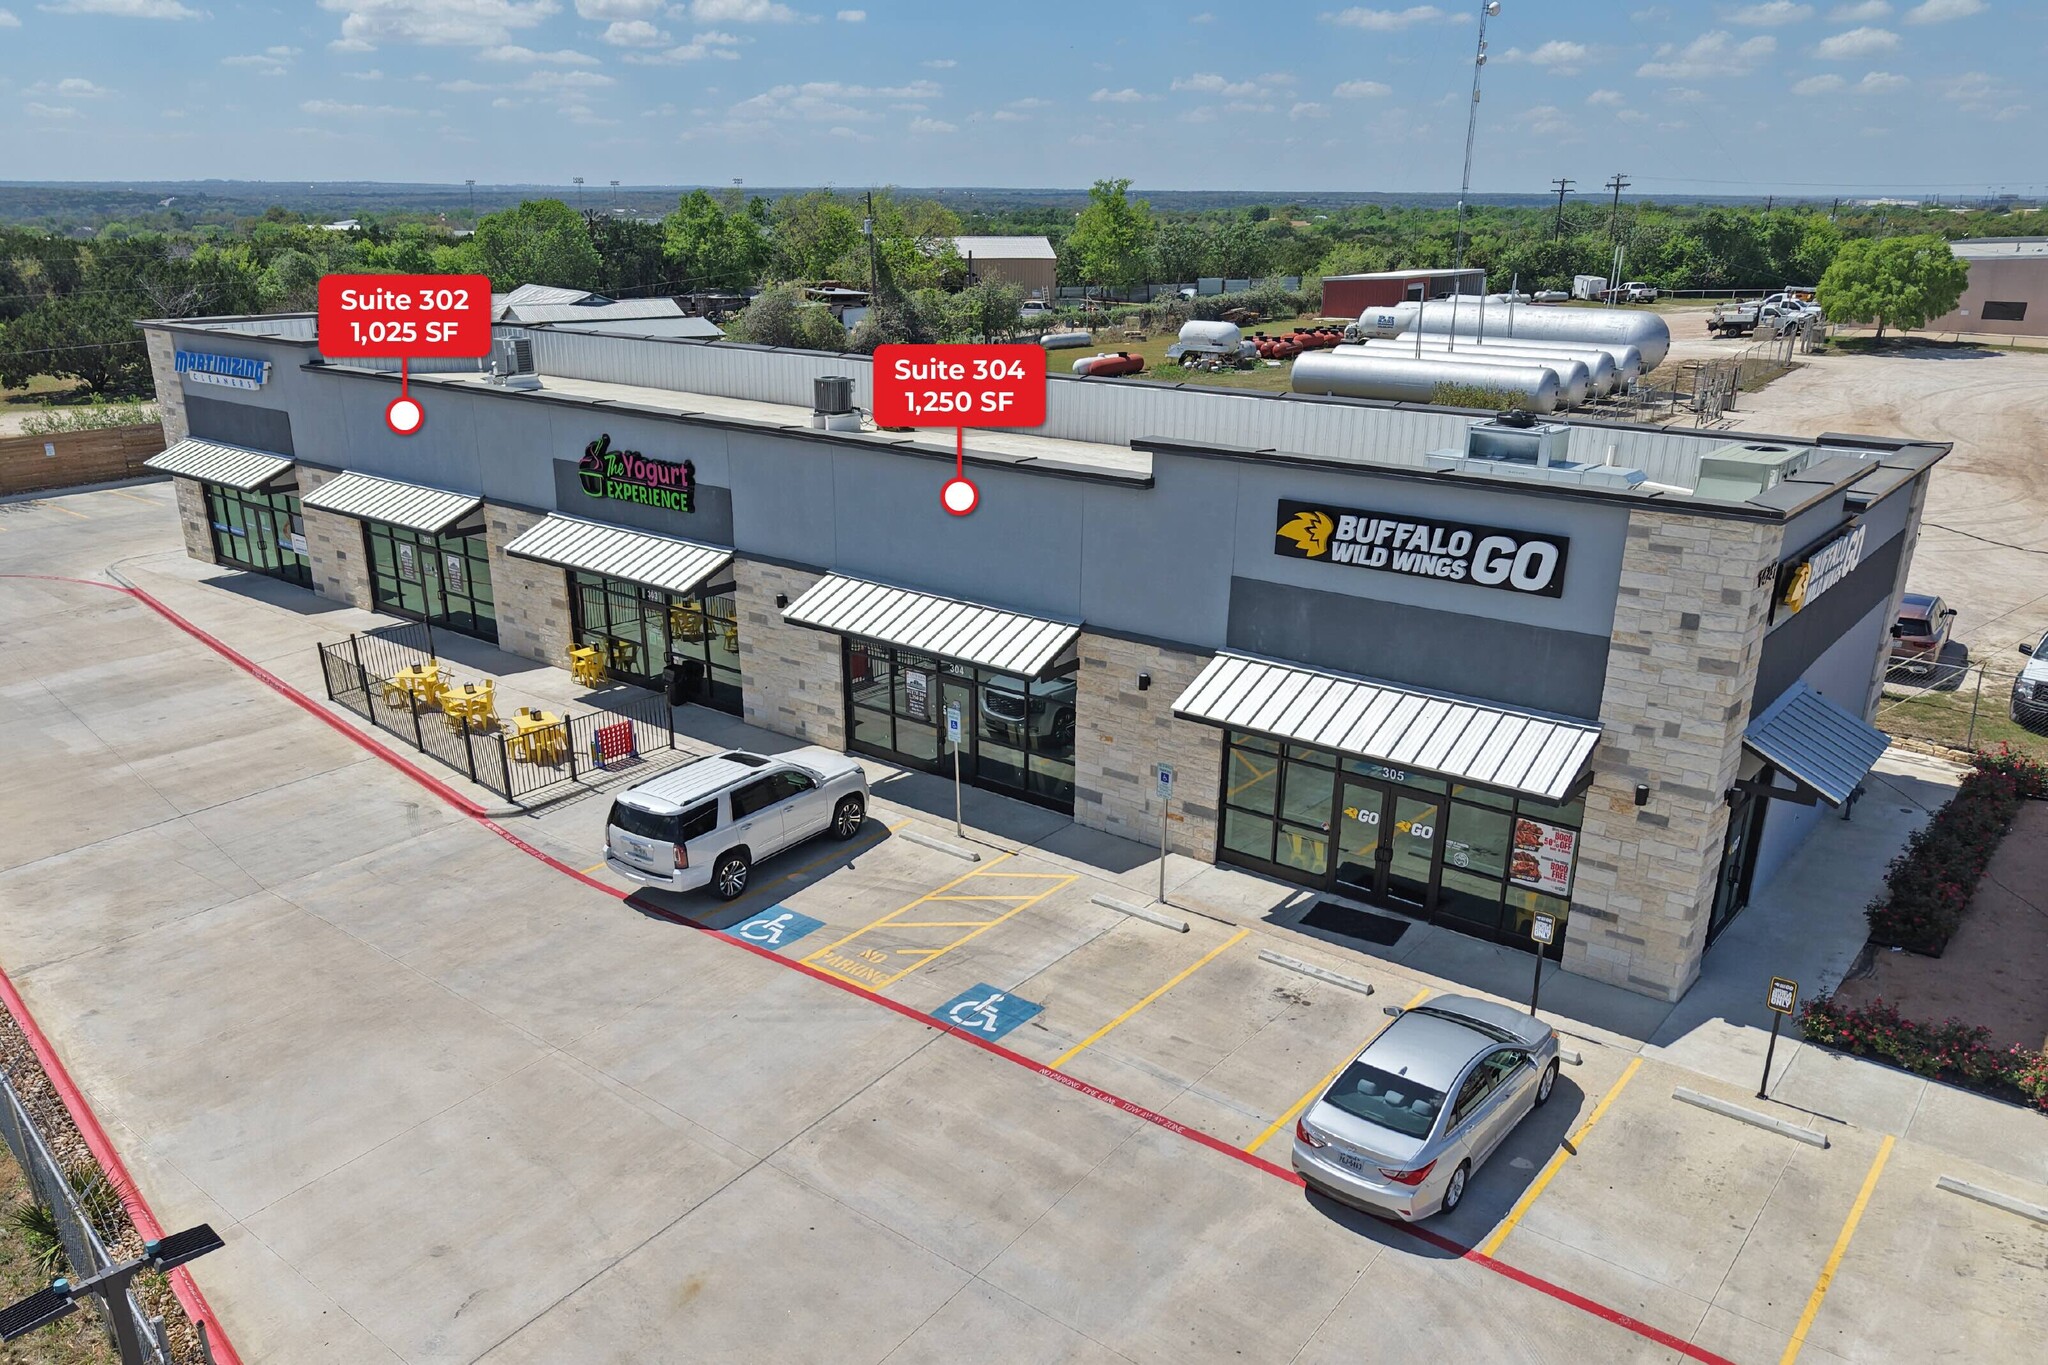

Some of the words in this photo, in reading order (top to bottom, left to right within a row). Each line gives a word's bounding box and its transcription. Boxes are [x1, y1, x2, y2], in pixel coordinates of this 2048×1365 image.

[174, 351, 265, 384] MARTINIZING
[193, 375, 253, 389] CLEANERS
[604, 454, 626, 477] The
[622, 452, 688, 488] Yogurt
[606, 480, 688, 512] EXPERIENCE
[1335, 514, 1474, 558] BUFFALO
[1841, 524, 1867, 578] GO
[1331, 541, 1388, 568] WILD
[1391, 550, 1469, 581] WINGS
[1470, 535, 1560, 592] GO
[949, 664, 965, 675] 304
[1382, 767, 1405, 781] 305
[1358, 809, 1379, 825] GO
[1410, 823, 1434, 839] GO
[1555, 832, 1573, 843] BOGO
[1544, 837, 1560, 848] 50%
[1560, 841, 1573, 851] OFF
[1550, 862, 1569, 873] BOGO
[1551, 871, 1568, 881] FREE
[858, 949, 888, 964] NO
[824, 951, 889, 983] PARKING
[1771, 998, 1791, 1008] ONLY
[1039, 1068, 1051, 1076] NO
[1050, 1073, 1081, 1089] PARKING
[1082, 1086, 1100, 1097] FIRE
[1163, 1120, 1186, 1134] ZONE
